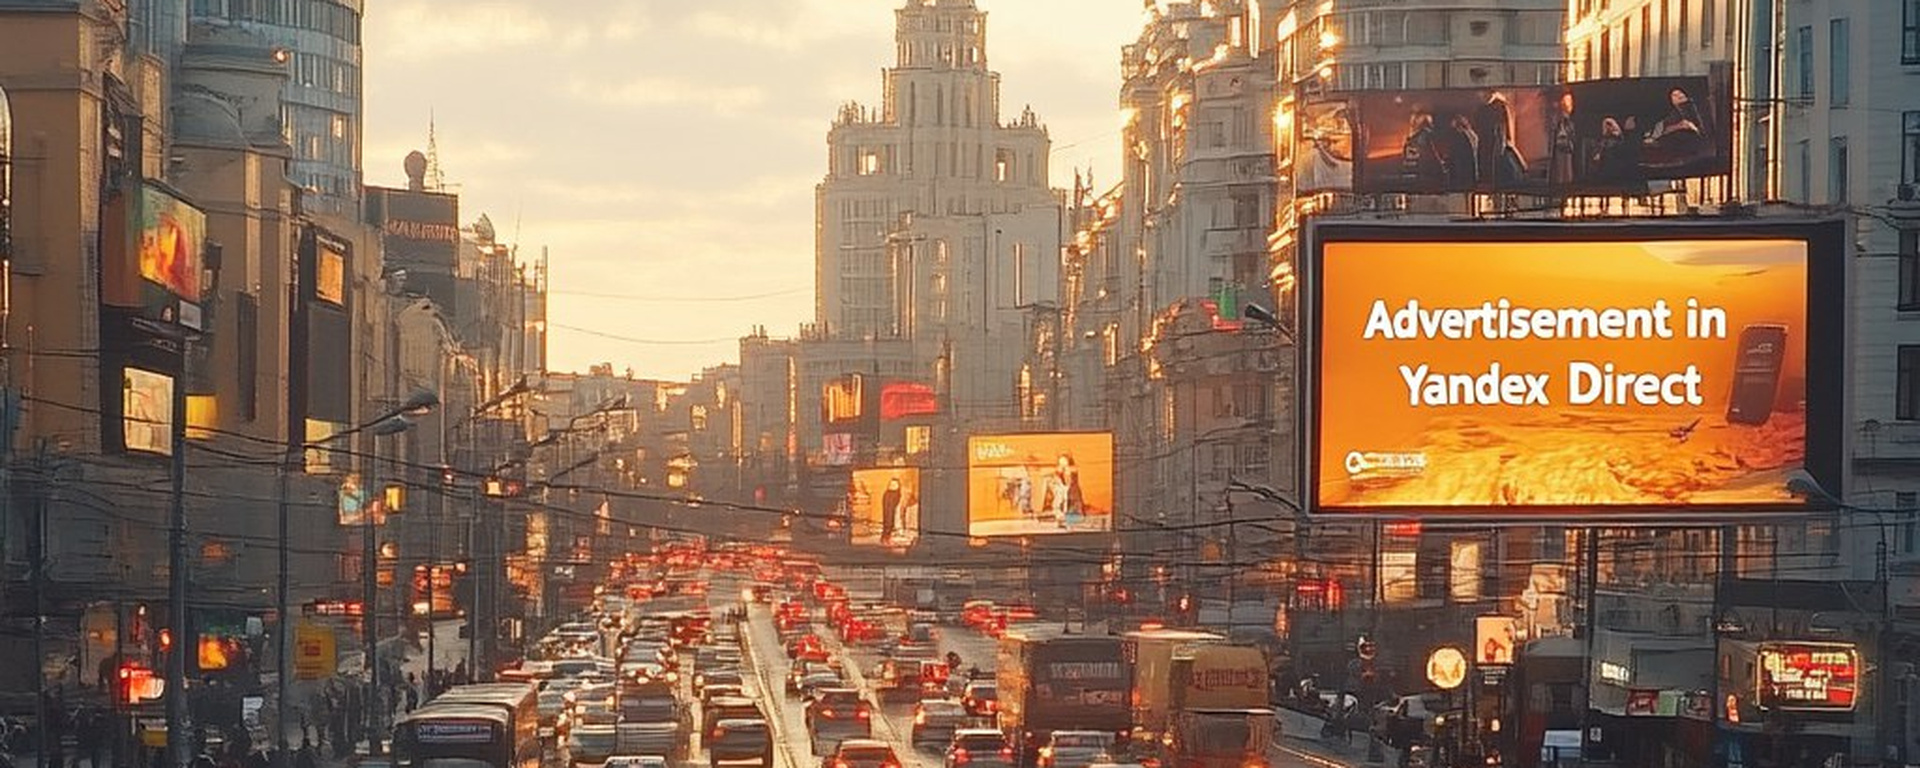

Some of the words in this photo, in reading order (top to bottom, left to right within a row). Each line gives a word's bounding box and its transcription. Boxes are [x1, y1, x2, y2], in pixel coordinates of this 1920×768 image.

[1363, 298, 1673, 339] Advertisement
[1687, 298, 1726, 338] in
[1399, 362, 1550, 407] Yandex
[1569, 362, 1703, 405] Direct
